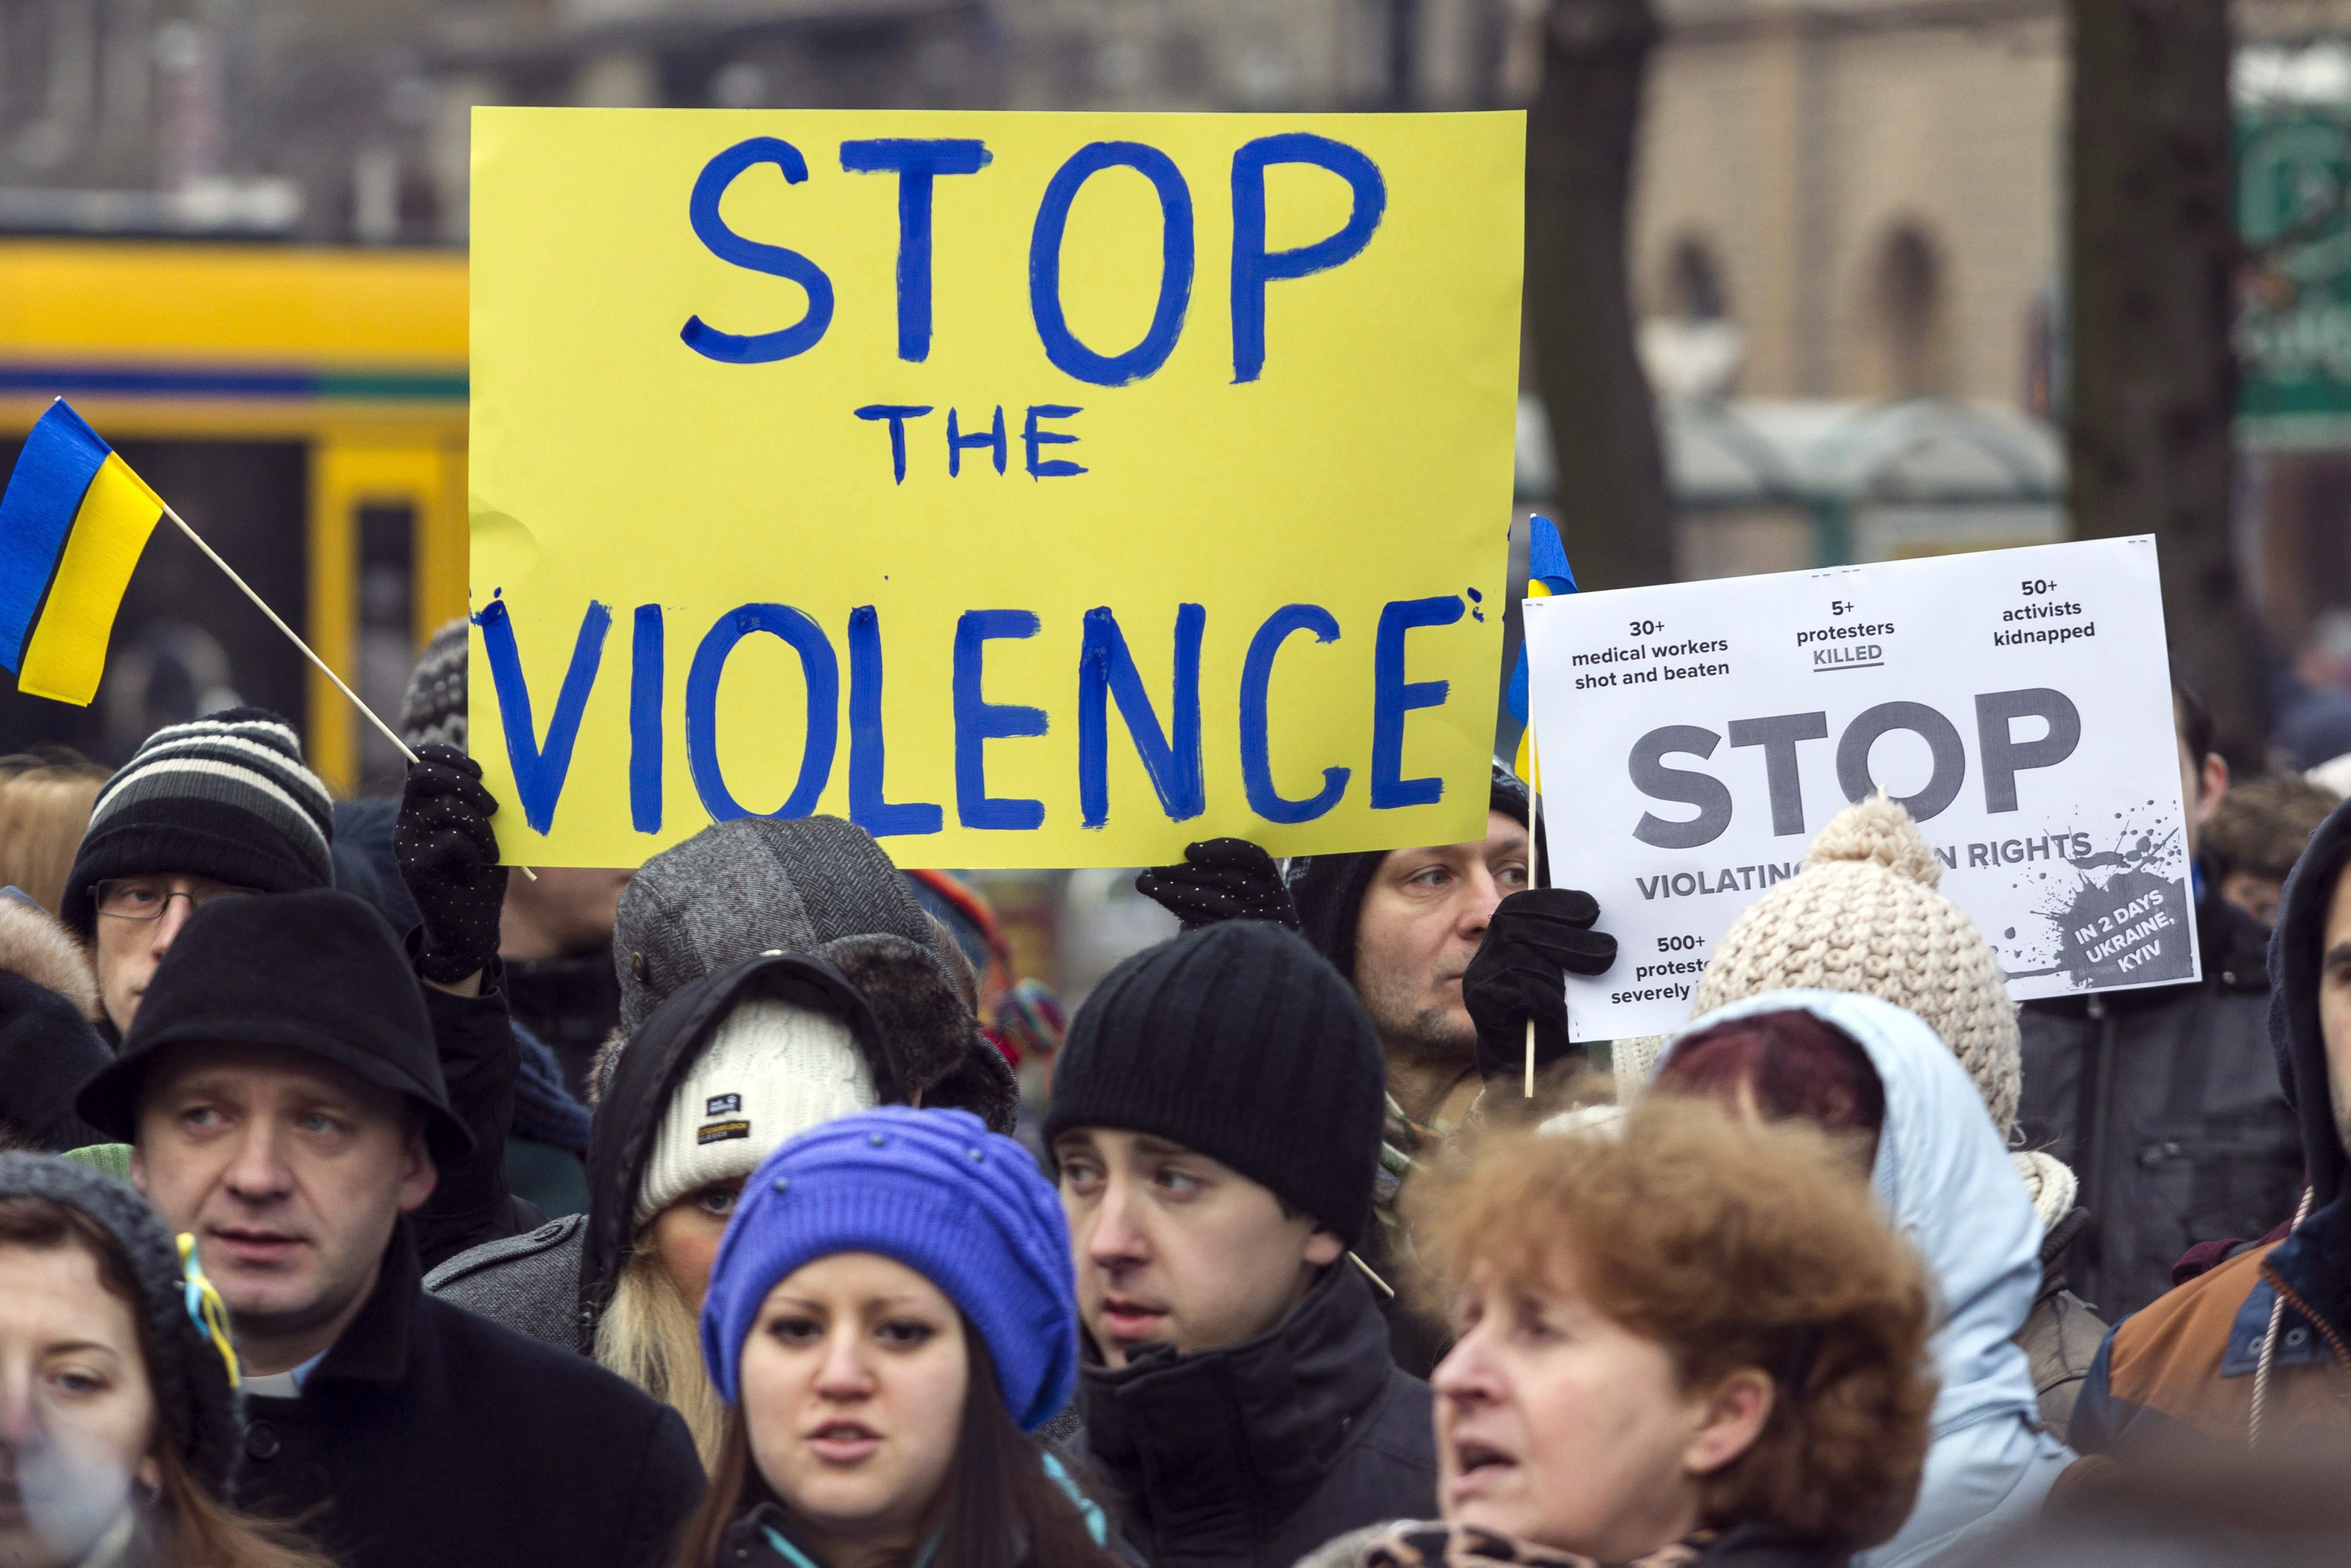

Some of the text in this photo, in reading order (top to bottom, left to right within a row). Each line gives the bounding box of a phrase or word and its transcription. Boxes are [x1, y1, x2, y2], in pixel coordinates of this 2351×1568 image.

[681, 133, 1386, 387] STOP
[854, 404, 1088, 485] THE
[2022, 579, 2058, 596] 50+
[1832, 600, 1855, 616] 5+
[2003, 601, 2082, 622] activists
[1629, 620, 1665, 636] 30+
[1797, 623, 1895, 647] protesters
[1993, 622, 2095, 646] kidnapped
[1572, 639, 1728, 666] medical workers
[1813, 645, 1883, 665] KILLED
[1575, 663, 1729, 690] shot and beaten
[478, 595, 1465, 839] VIOLENCE
[1628, 687, 2082, 850] STOP
[1968, 832, 2092, 867] RIGHTS
[2073, 889, 2164, 945] IN 2 DAYS
[1656, 934, 1705, 952] 500+
[2085, 910, 2176, 964] UKRAINE,
[2116, 938, 2161, 973] KYIV
[1611, 983, 1690, 1005] severely
